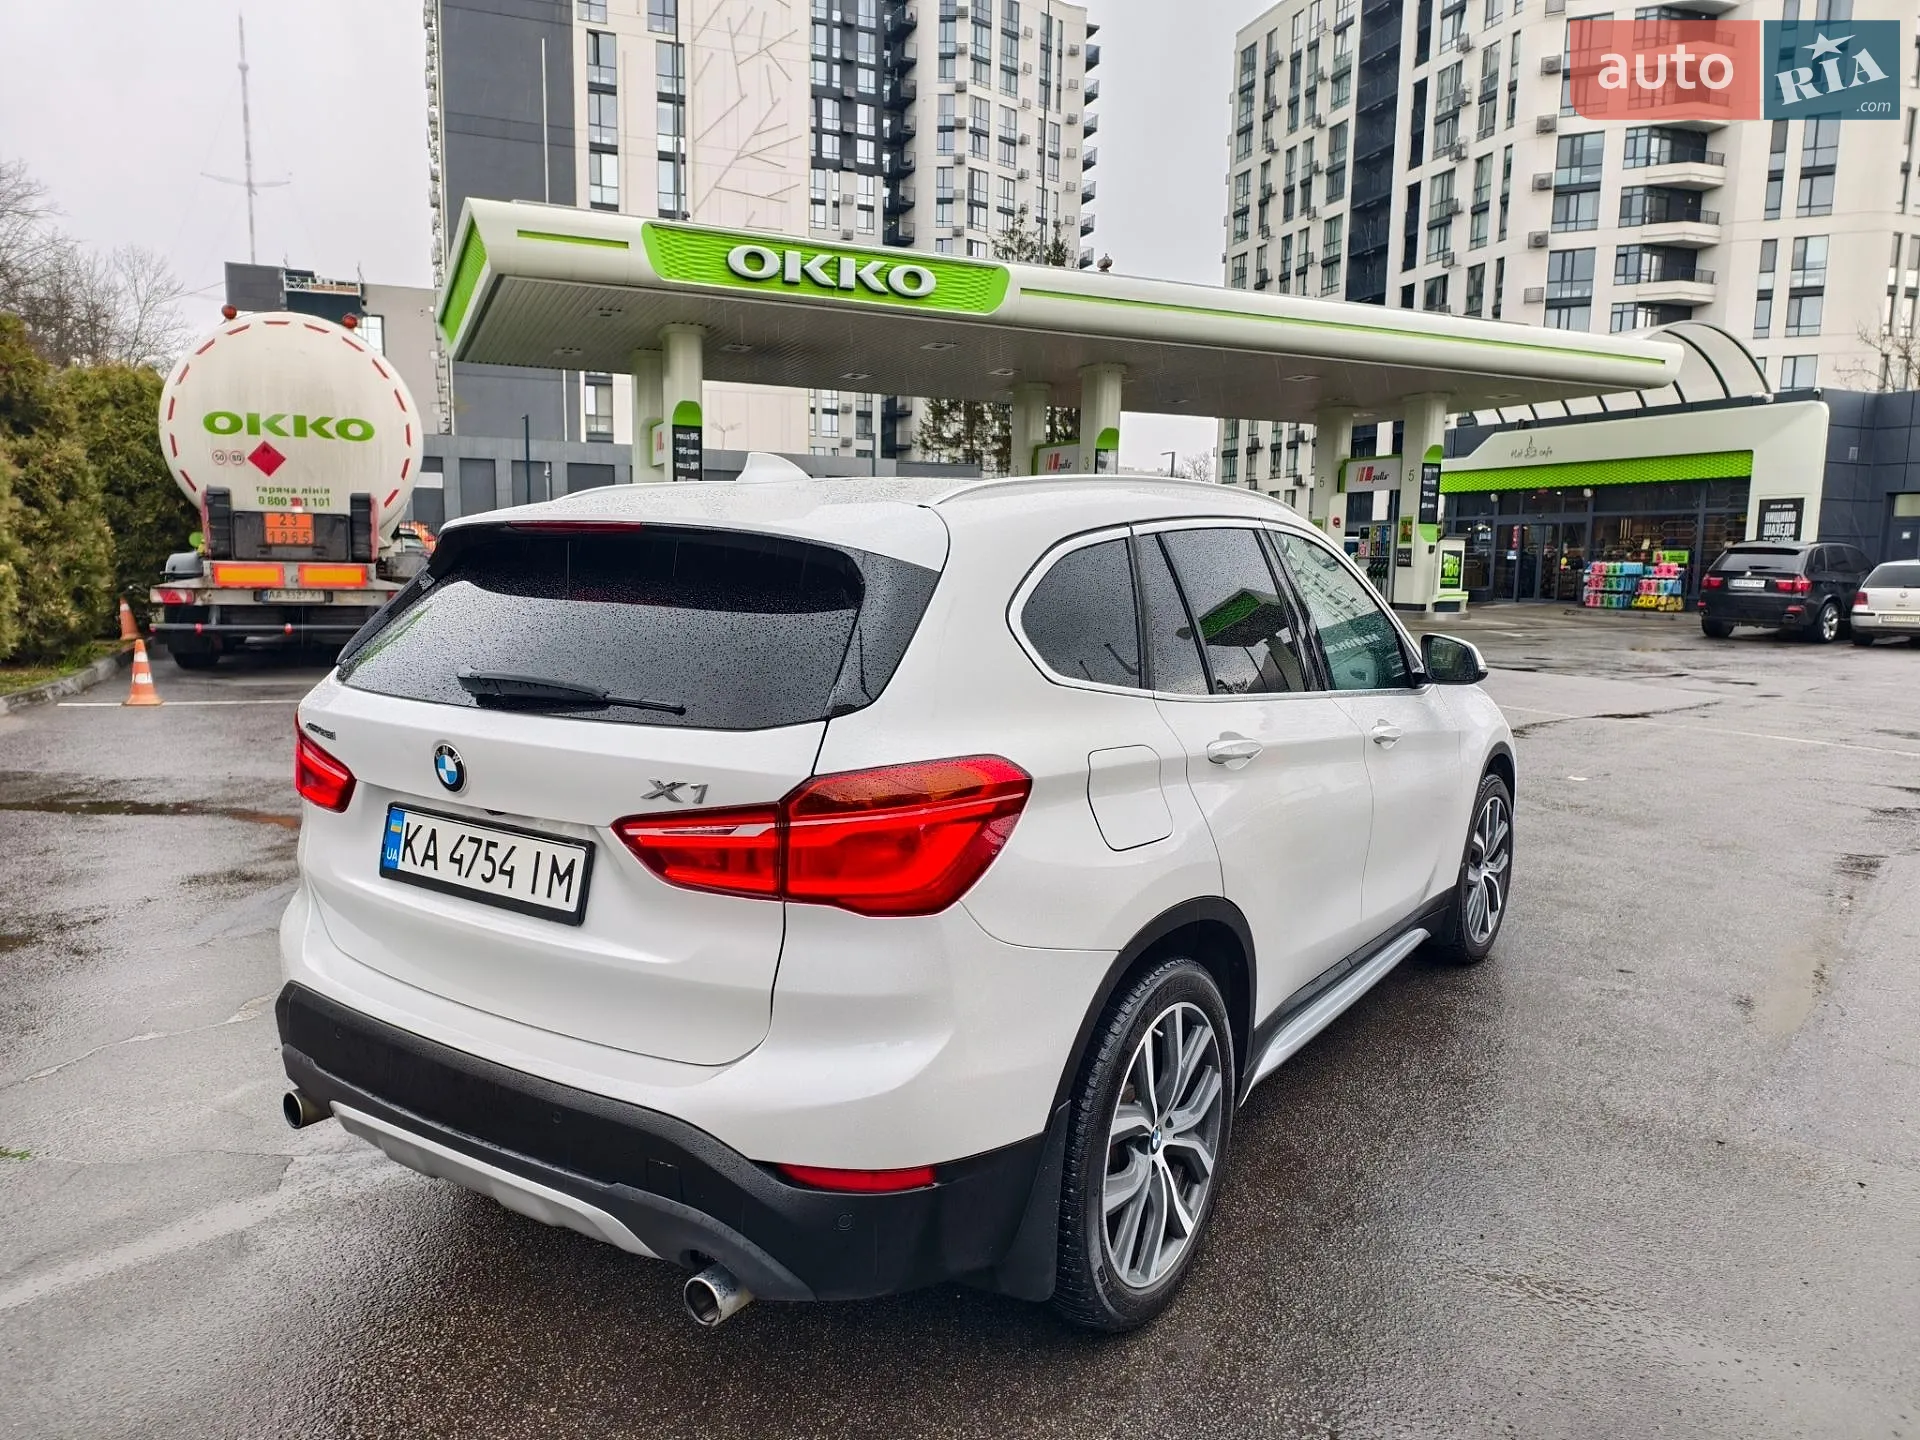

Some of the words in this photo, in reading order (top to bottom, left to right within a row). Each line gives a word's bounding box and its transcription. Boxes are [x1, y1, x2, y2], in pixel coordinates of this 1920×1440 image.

[727, 244, 937, 297] OKKO
[203, 411, 375, 442] OKKO
[690, 432, 699, 440] 95
[214, 454, 225, 462] 50
[1408, 469, 1415, 482] 5
[1319, 476, 1325, 488] 5
[256, 486, 297, 495] гаряча
[258, 496, 265, 505] 0
[267, 496, 287, 506] 800
[312, 497, 330, 506] 101
[279, 514, 298, 526] 23
[640, 779, 708, 804] X1
[386, 848, 397, 861] UA
[401, 822, 438, 870] KA
[449, 834, 517, 889] 4754
[531, 850, 576, 902] IM
